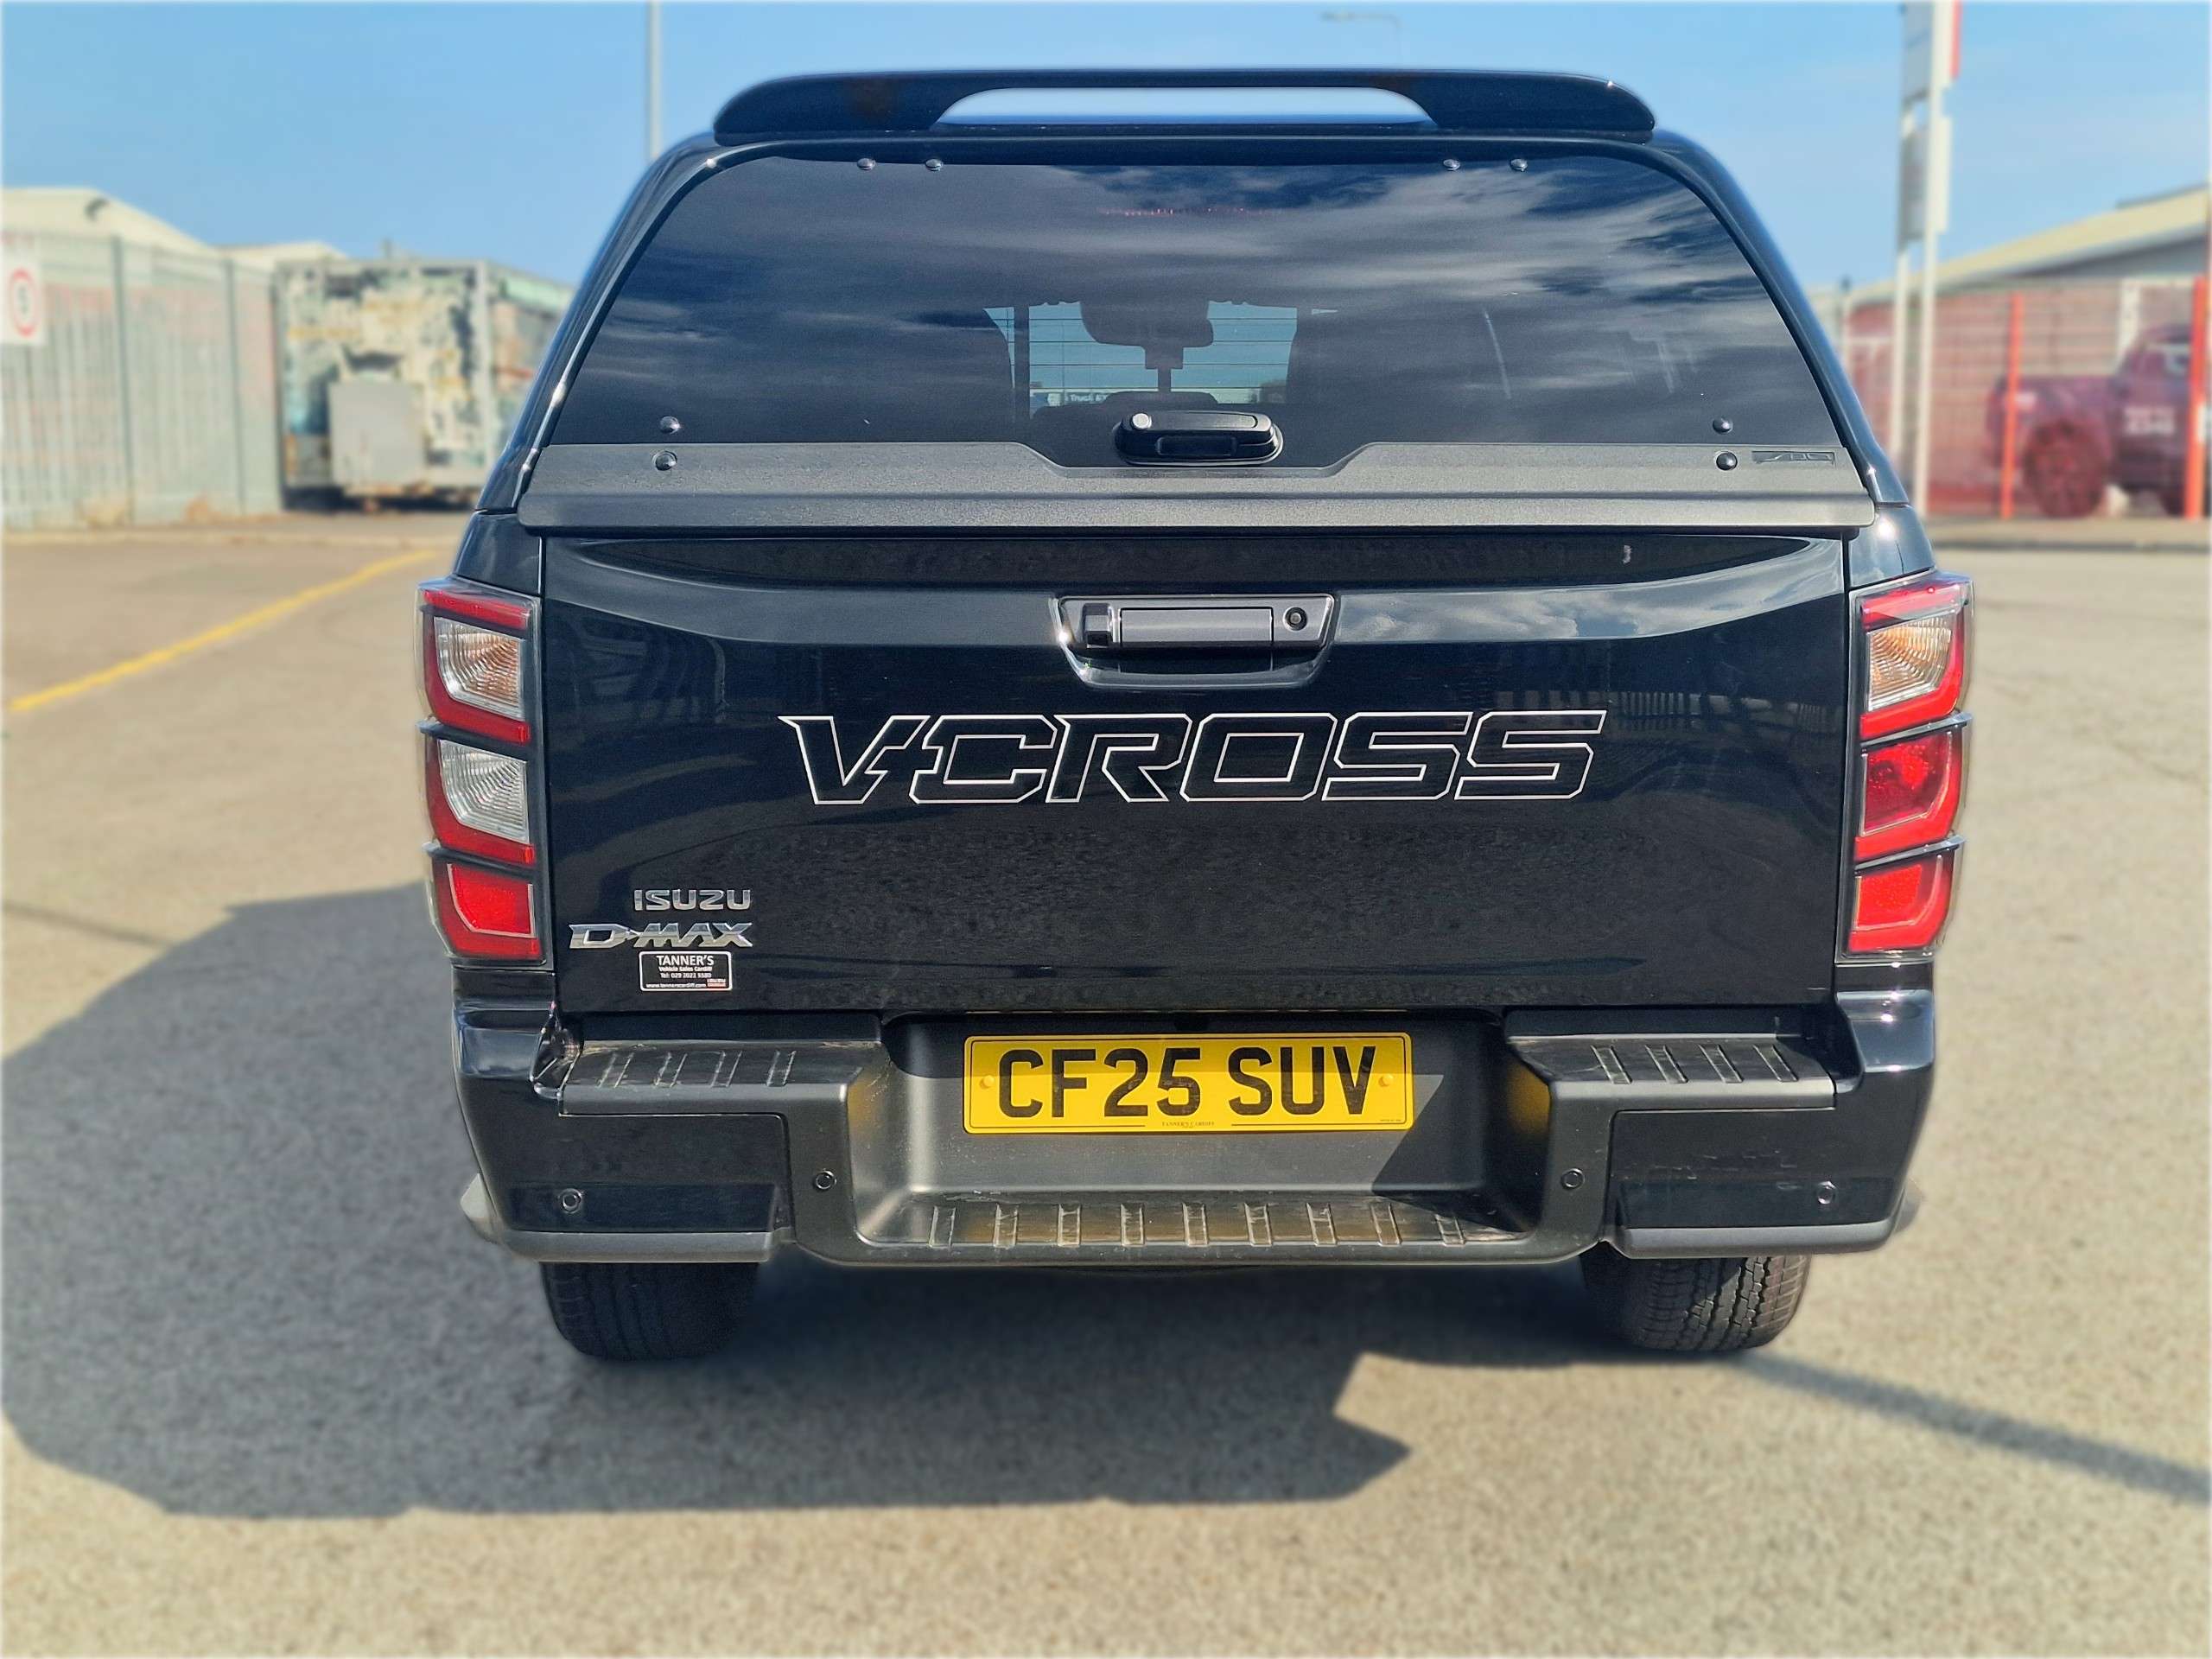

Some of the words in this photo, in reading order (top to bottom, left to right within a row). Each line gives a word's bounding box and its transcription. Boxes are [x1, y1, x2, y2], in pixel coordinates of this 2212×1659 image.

[634, 889, 751, 911] ISUZU
[569, 922, 753, 949] D-MAX
[656, 955, 715, 966] TANNER'S
[999, 1047, 1200, 1118] CF25
[1228, 1046, 1376, 1116] SUV
